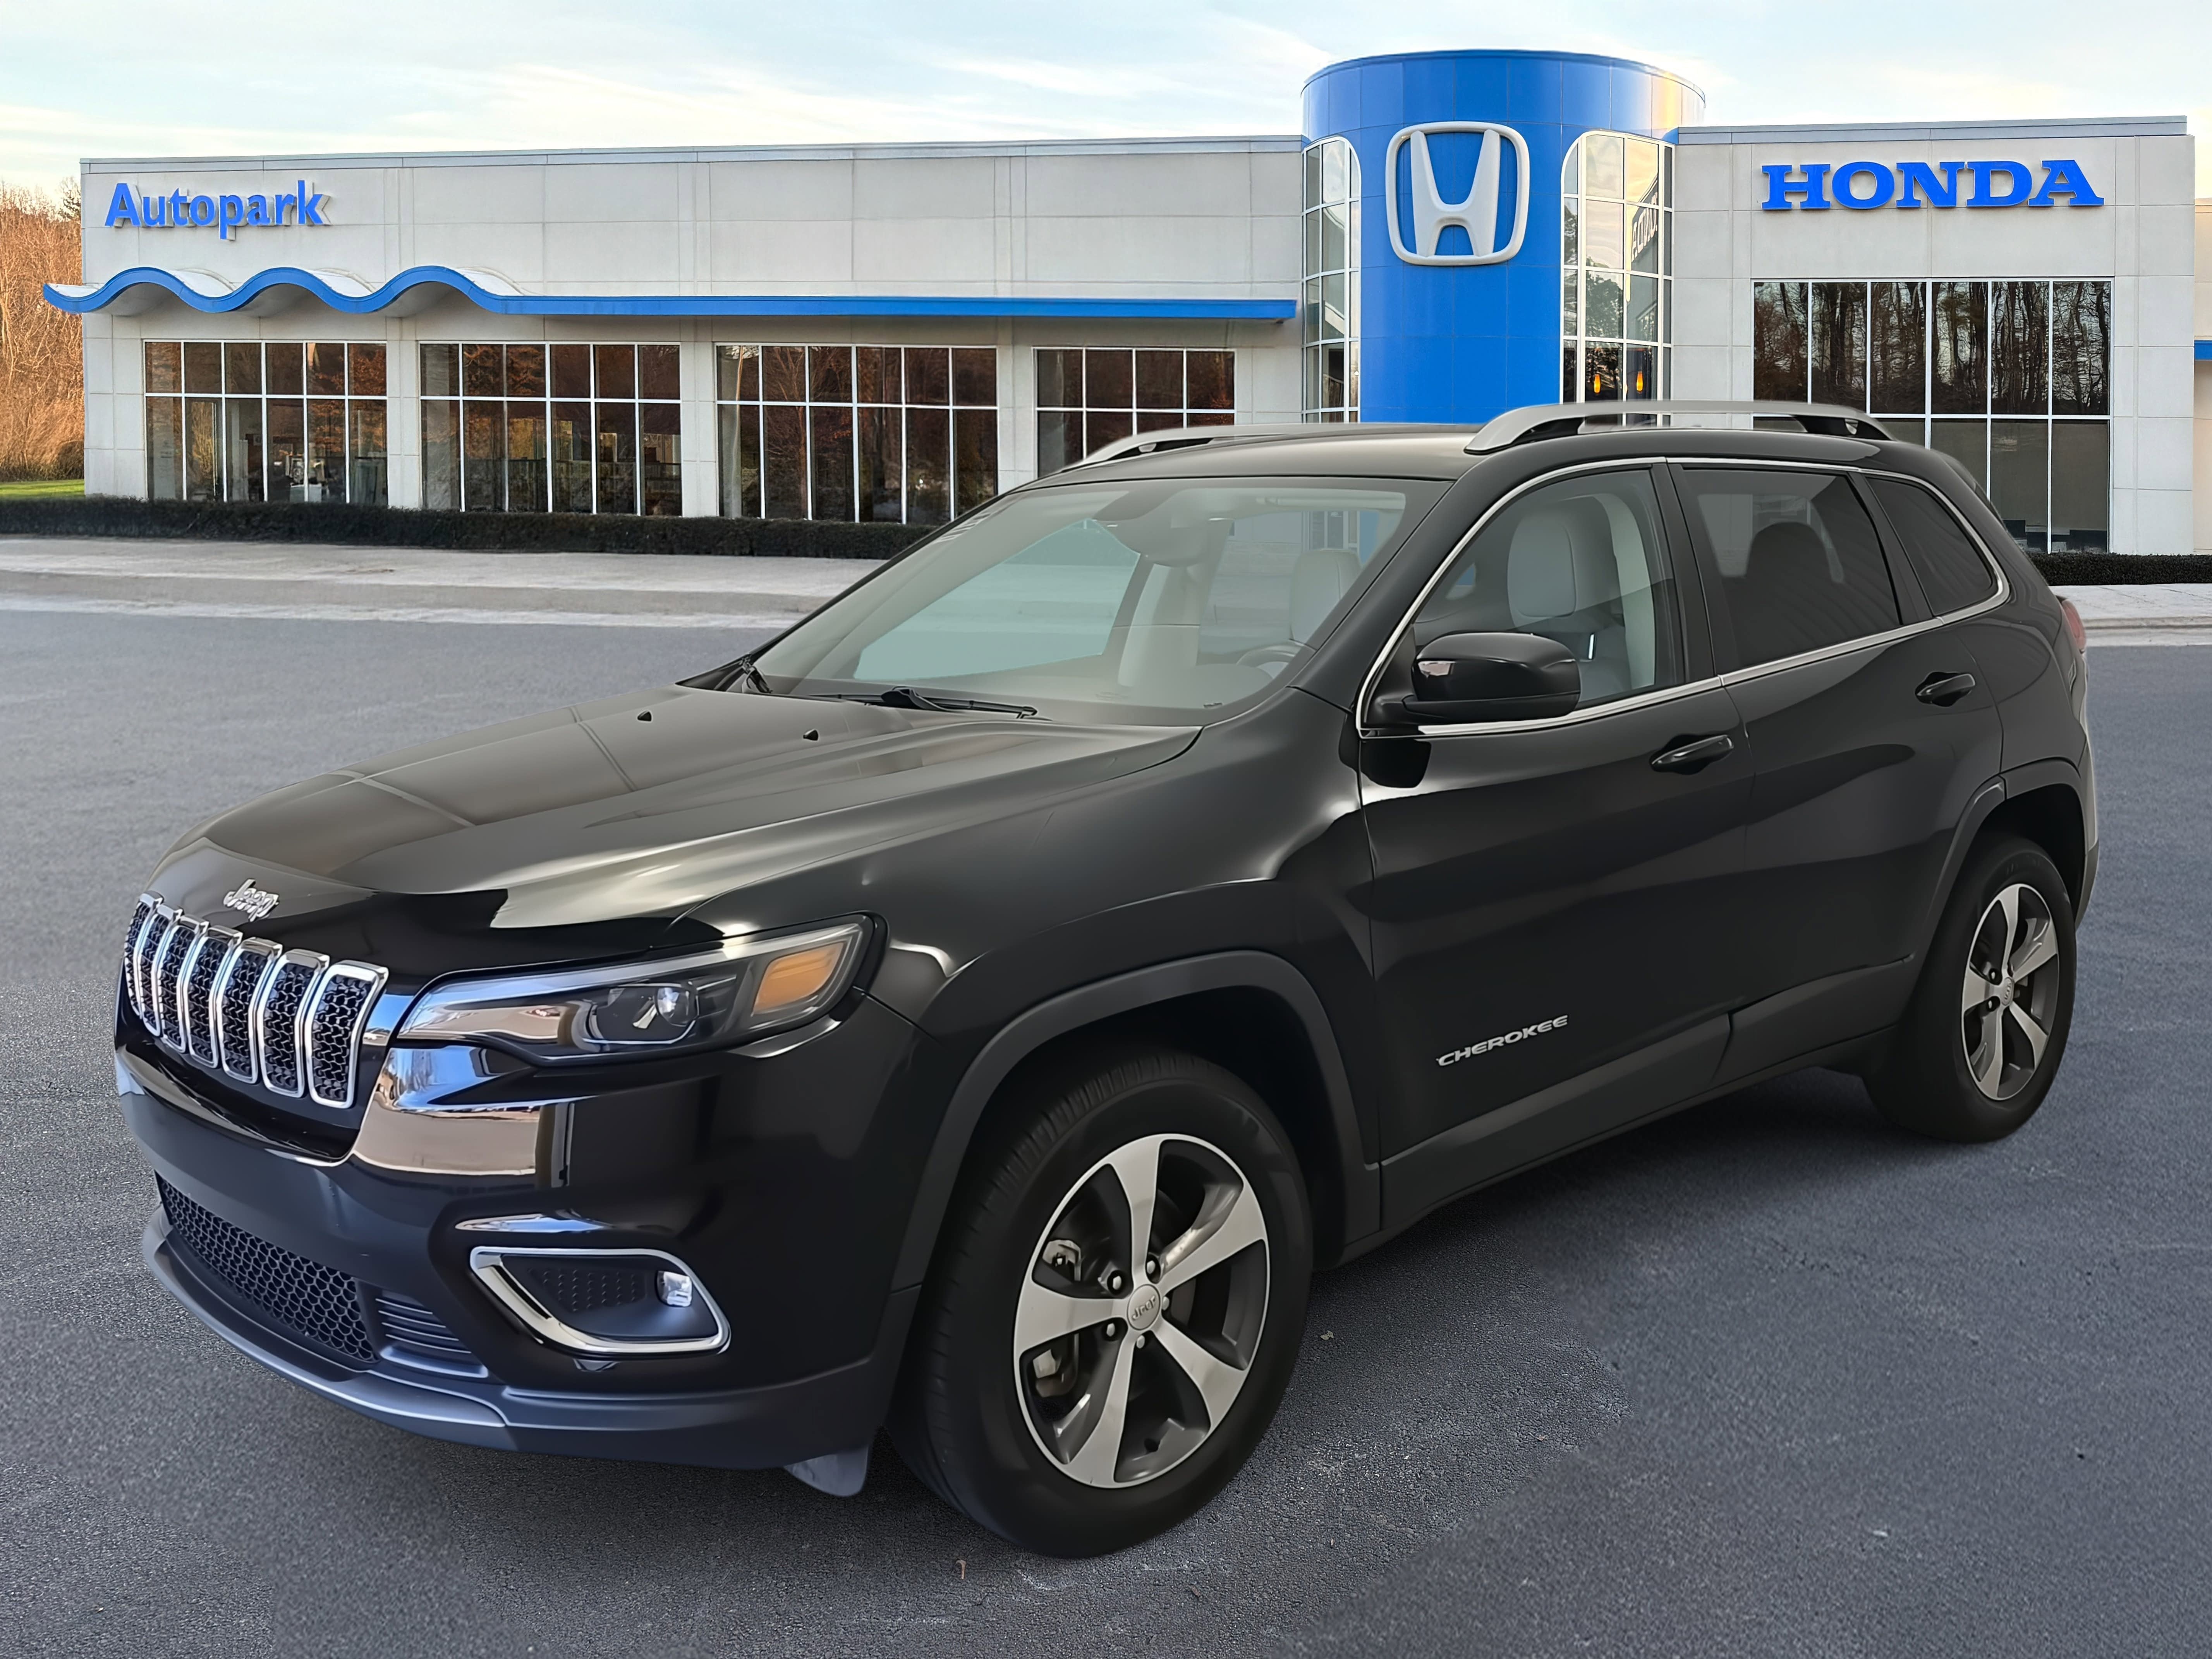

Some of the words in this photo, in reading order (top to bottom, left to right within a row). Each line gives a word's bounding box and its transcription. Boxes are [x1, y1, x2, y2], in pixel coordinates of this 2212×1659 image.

[105, 180, 330, 240] Autopark
[1762, 159, 2104, 210] HONDA
[223, 879, 279, 922] Jeep
[1436, 1015, 1568, 1066] CHEROKEE
